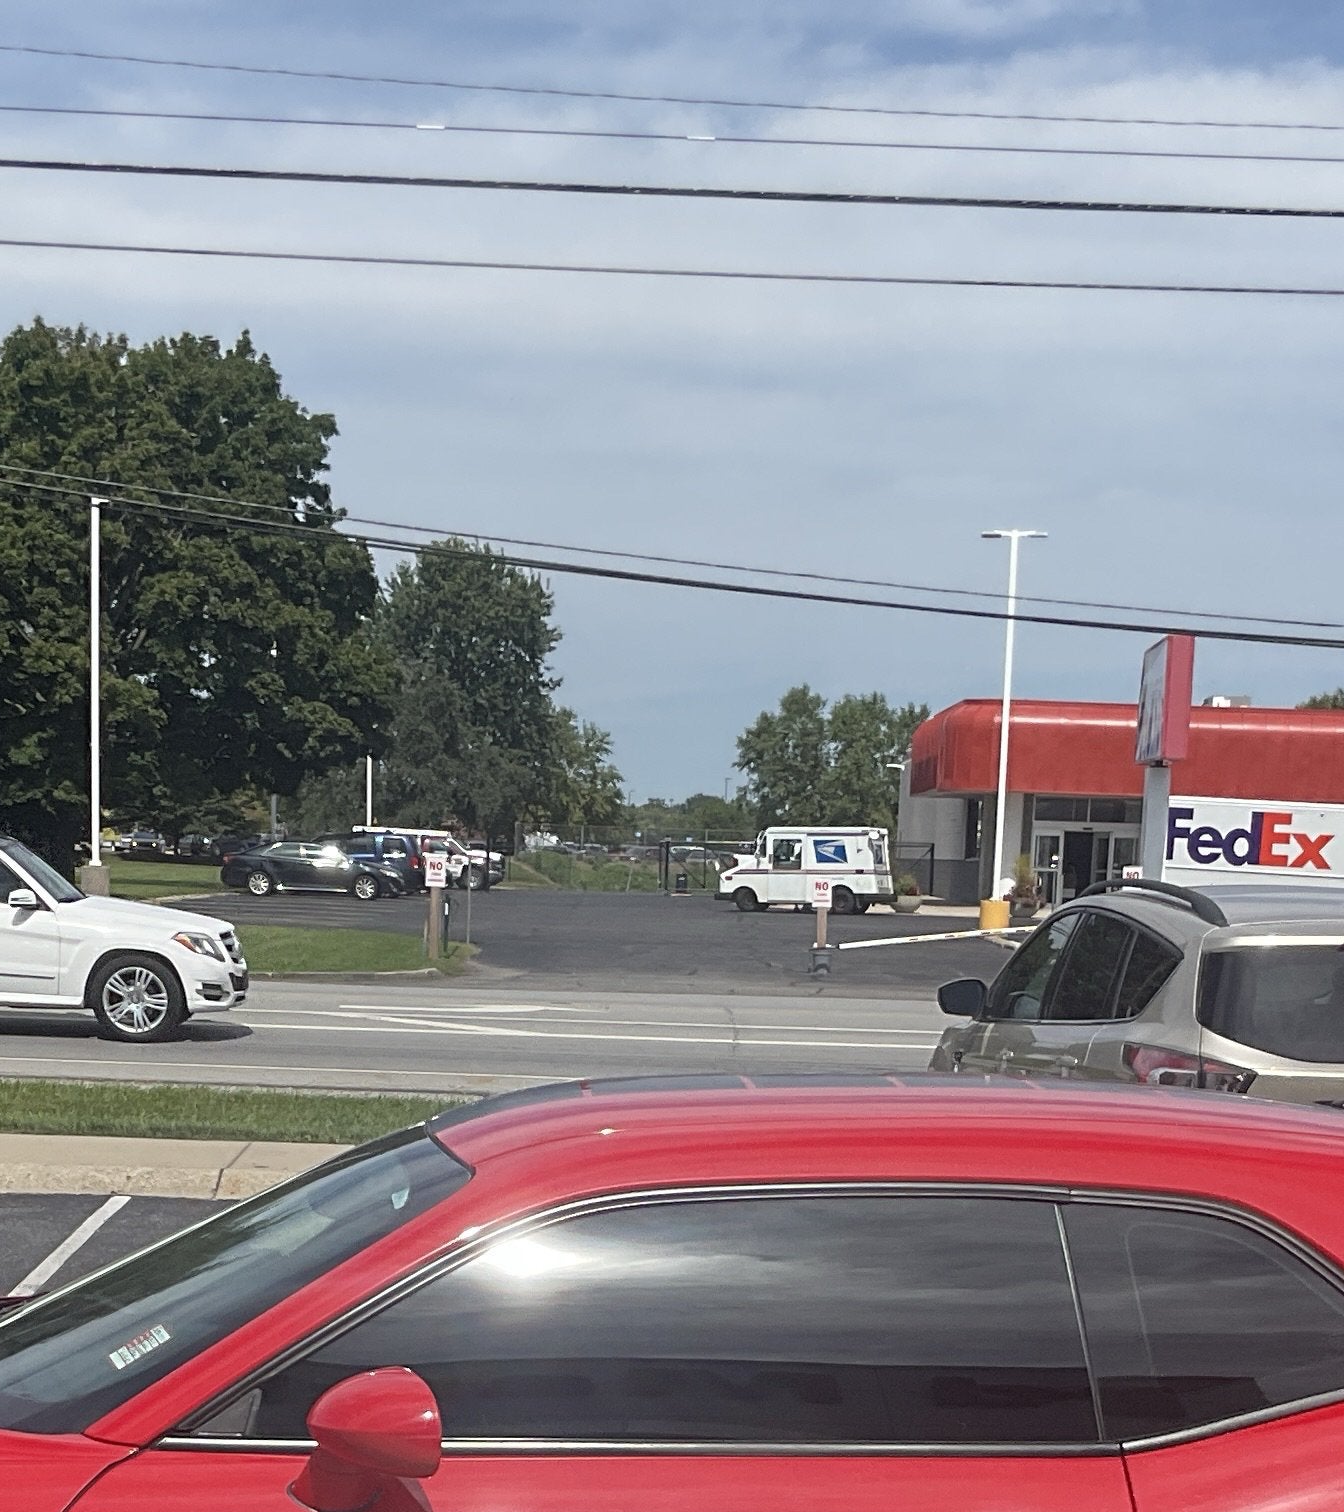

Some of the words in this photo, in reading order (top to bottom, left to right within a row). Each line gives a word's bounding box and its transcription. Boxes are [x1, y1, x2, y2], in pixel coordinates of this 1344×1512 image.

[1165, 807, 1335, 870] FedEx
[429, 861, 443, 870] NO
[815, 881, 829, 891] NO
